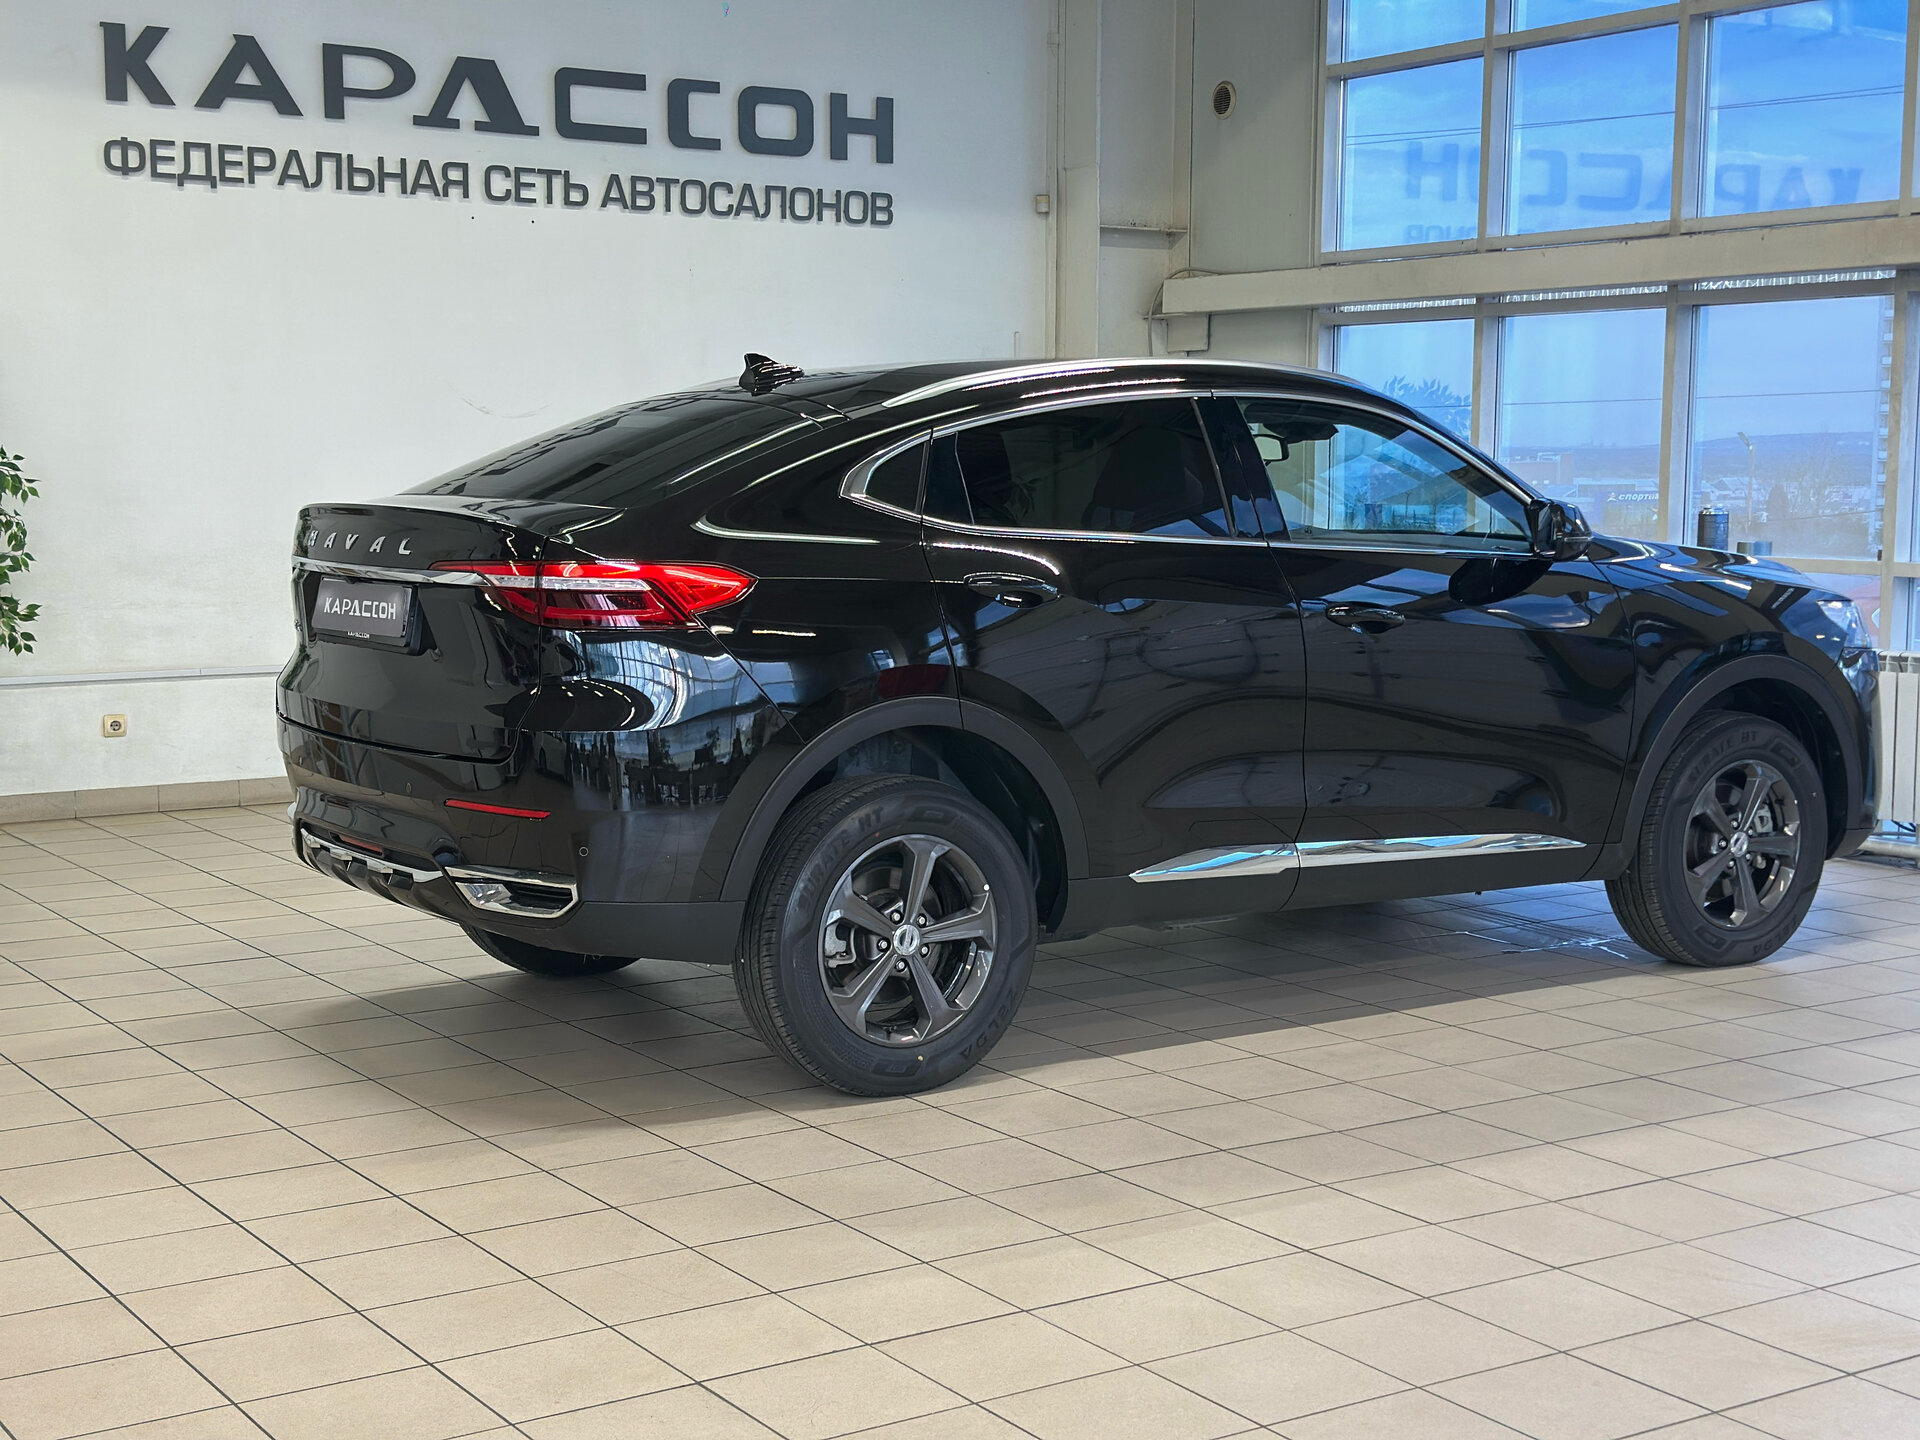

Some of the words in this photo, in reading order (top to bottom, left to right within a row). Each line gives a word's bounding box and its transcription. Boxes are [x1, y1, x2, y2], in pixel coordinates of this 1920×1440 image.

[99, 21, 894, 164] КАРАССОН
[104, 136, 469, 199] ФЕДЕРАЛЬНАЯ
[484, 164, 590, 207] СЕТЬ
[600, 173, 894, 226] АВТОСАЛОНОВ
[307, 530, 412, 556] HAVAL
[323, 597, 397, 620] КАРАССОН
